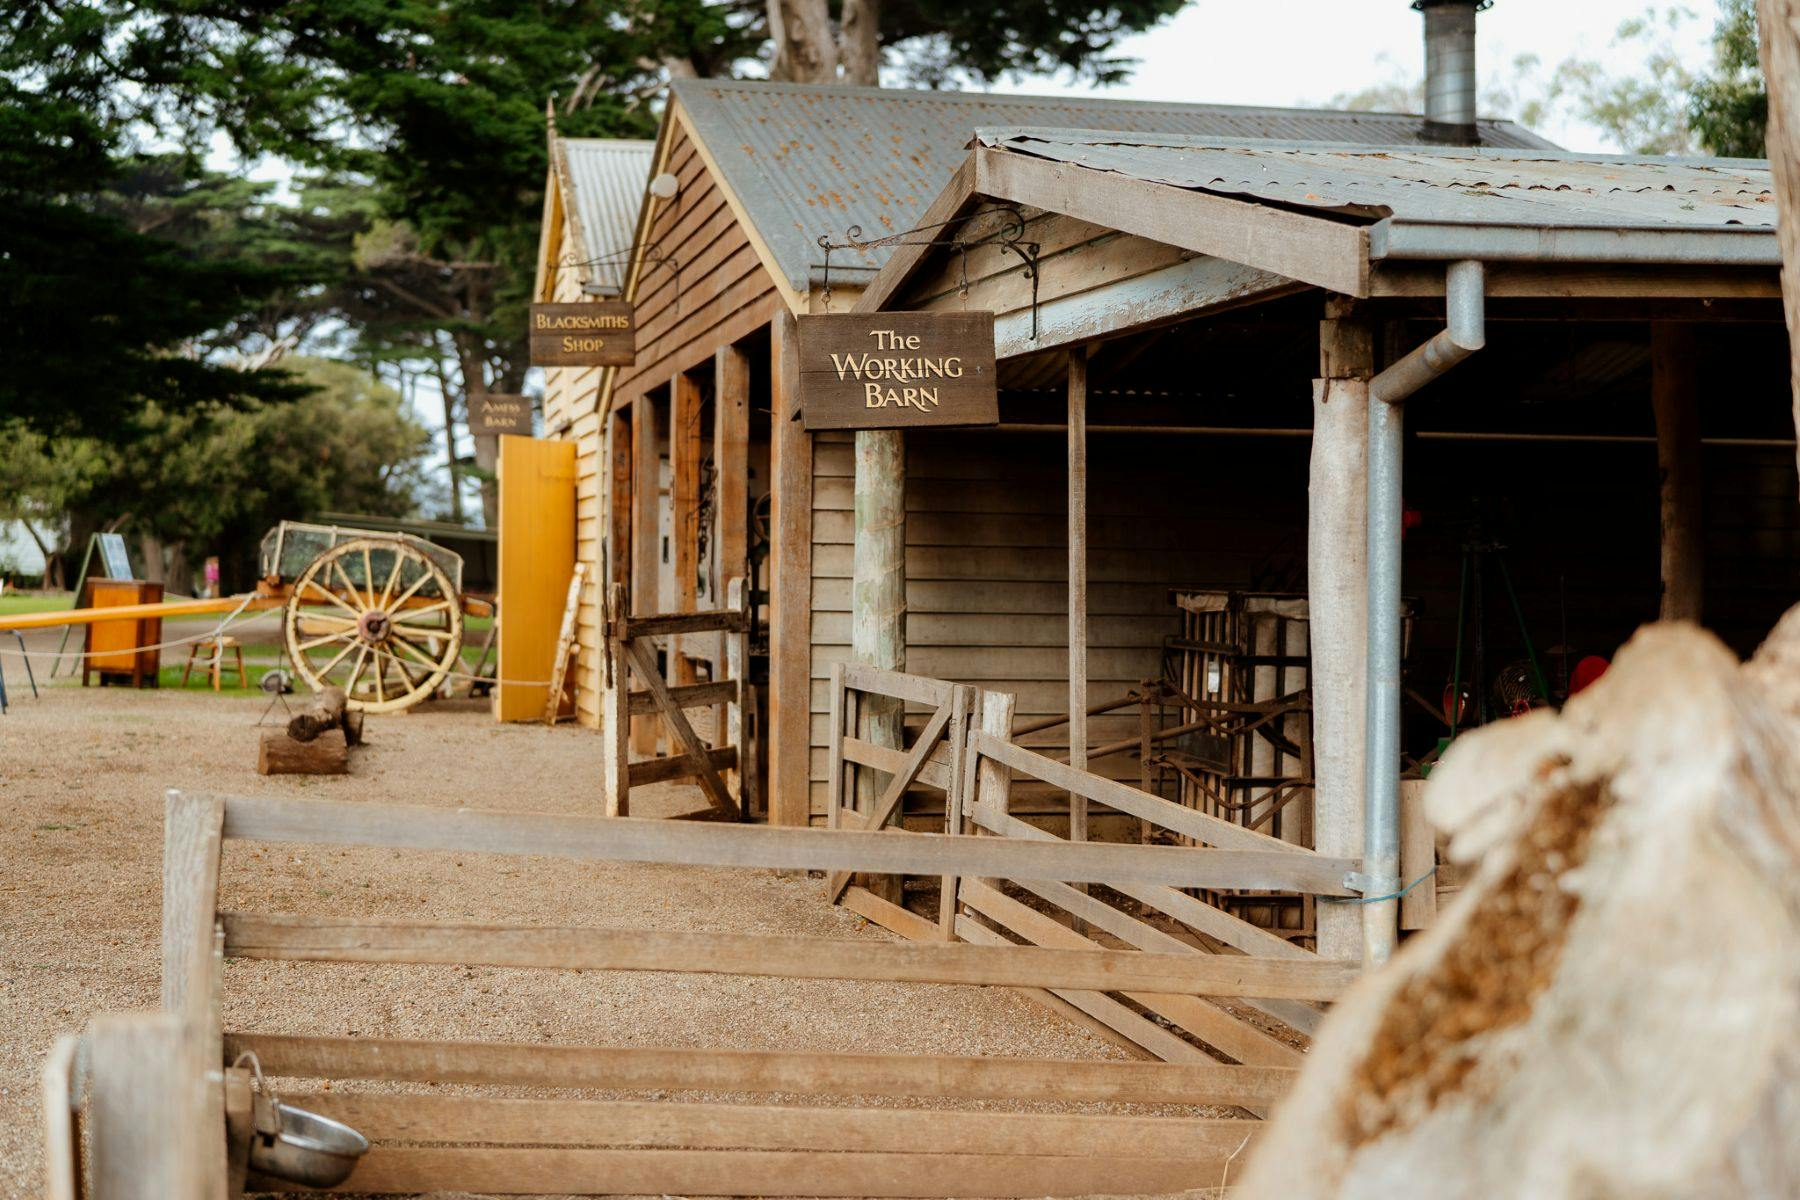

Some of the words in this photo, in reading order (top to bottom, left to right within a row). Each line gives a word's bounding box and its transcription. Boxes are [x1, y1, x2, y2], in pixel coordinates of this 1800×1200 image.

[536, 314, 630, 329] BLACKSMITHS
[563, 336, 604, 353] SHOP
[869, 330, 920, 350] The
[830, 353, 963, 383] WORKING
[864, 383, 939, 412] BARN
